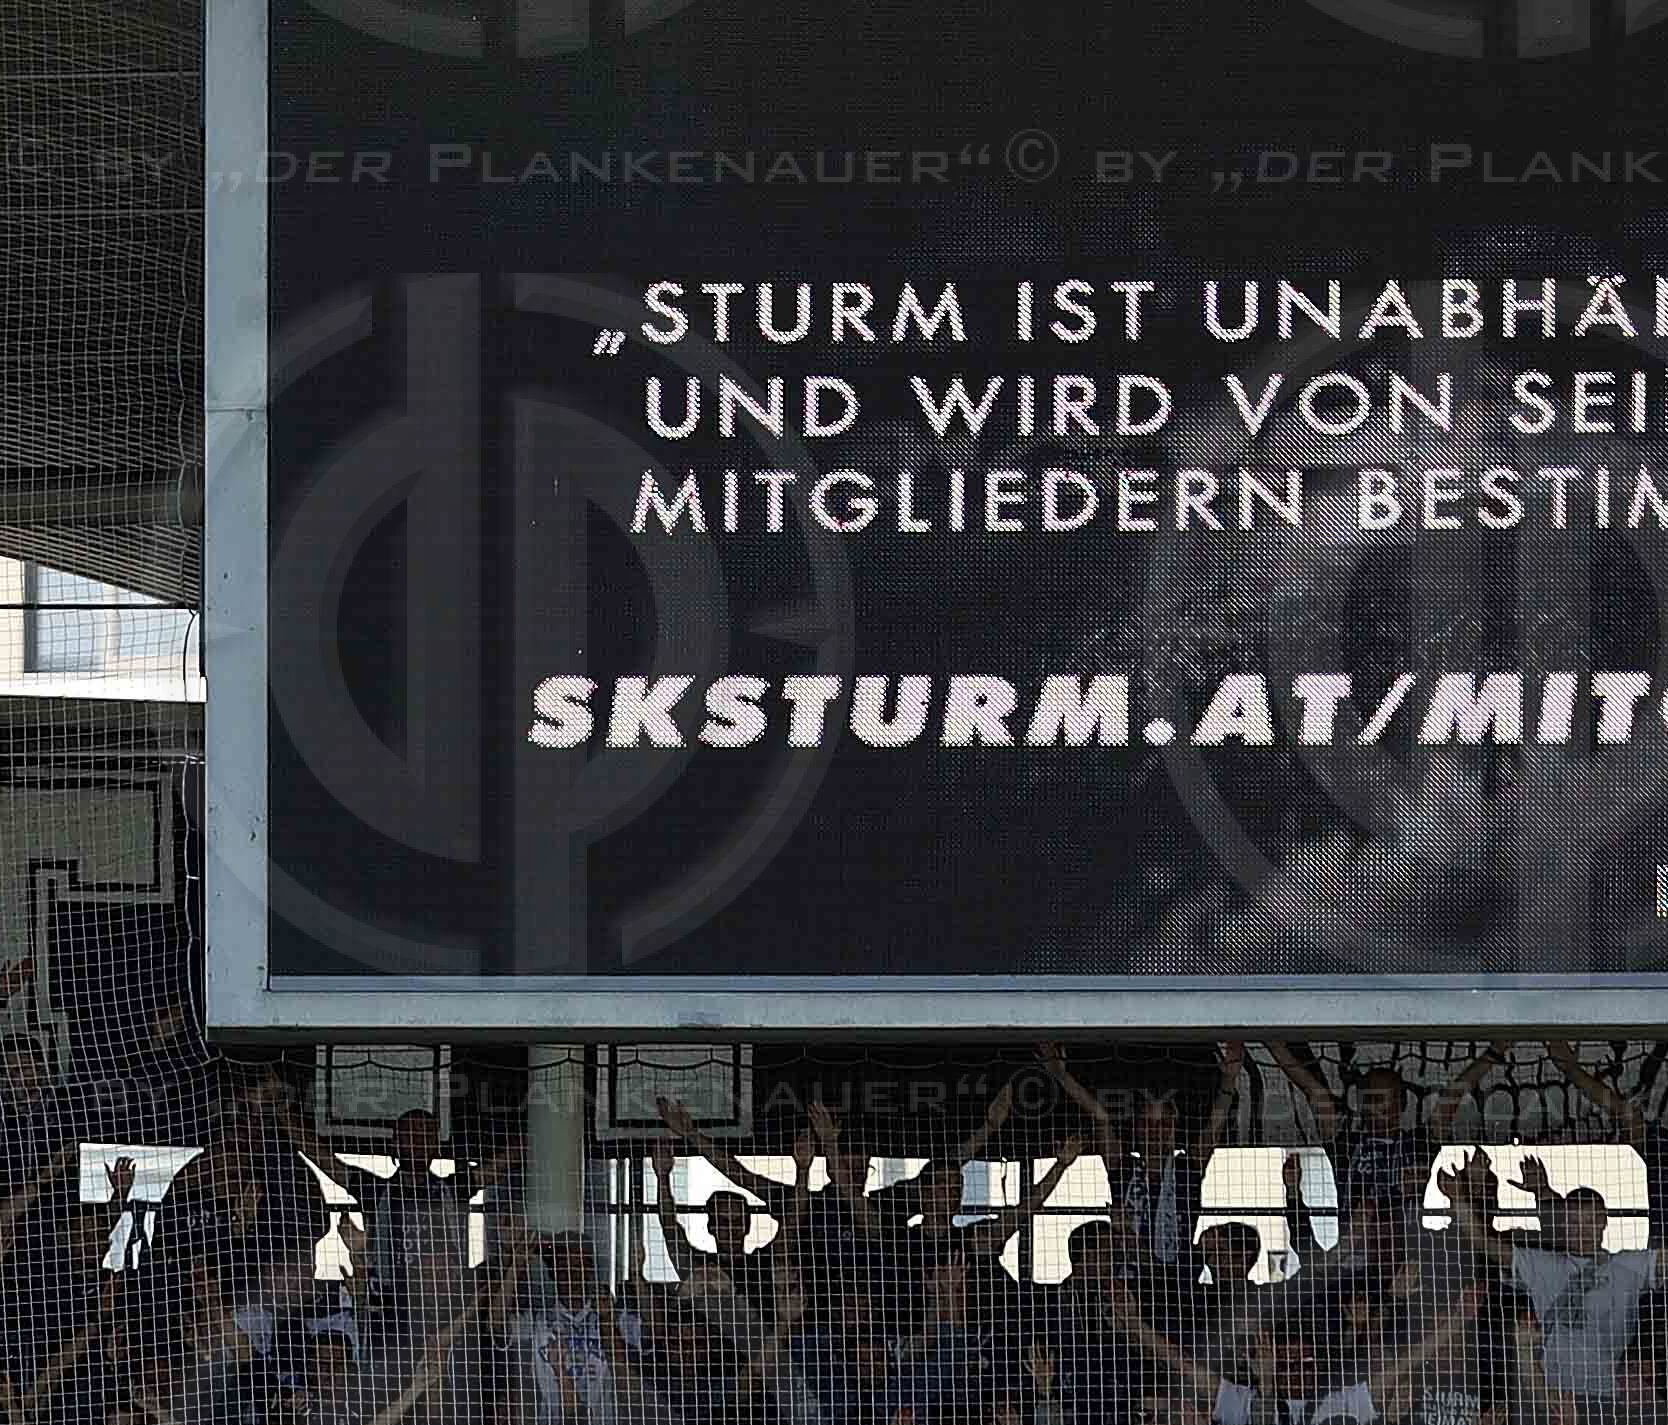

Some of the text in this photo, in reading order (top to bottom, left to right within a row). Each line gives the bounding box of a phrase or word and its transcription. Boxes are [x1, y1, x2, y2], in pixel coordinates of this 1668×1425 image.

[1016, 279, 1157, 345] IST
[644, 375, 862, 440] UND
[910, 373, 1173, 438] WIRD
[1225, 370, 1453, 437] VON
[628, 465, 1306, 533] MITGLIEDERN
